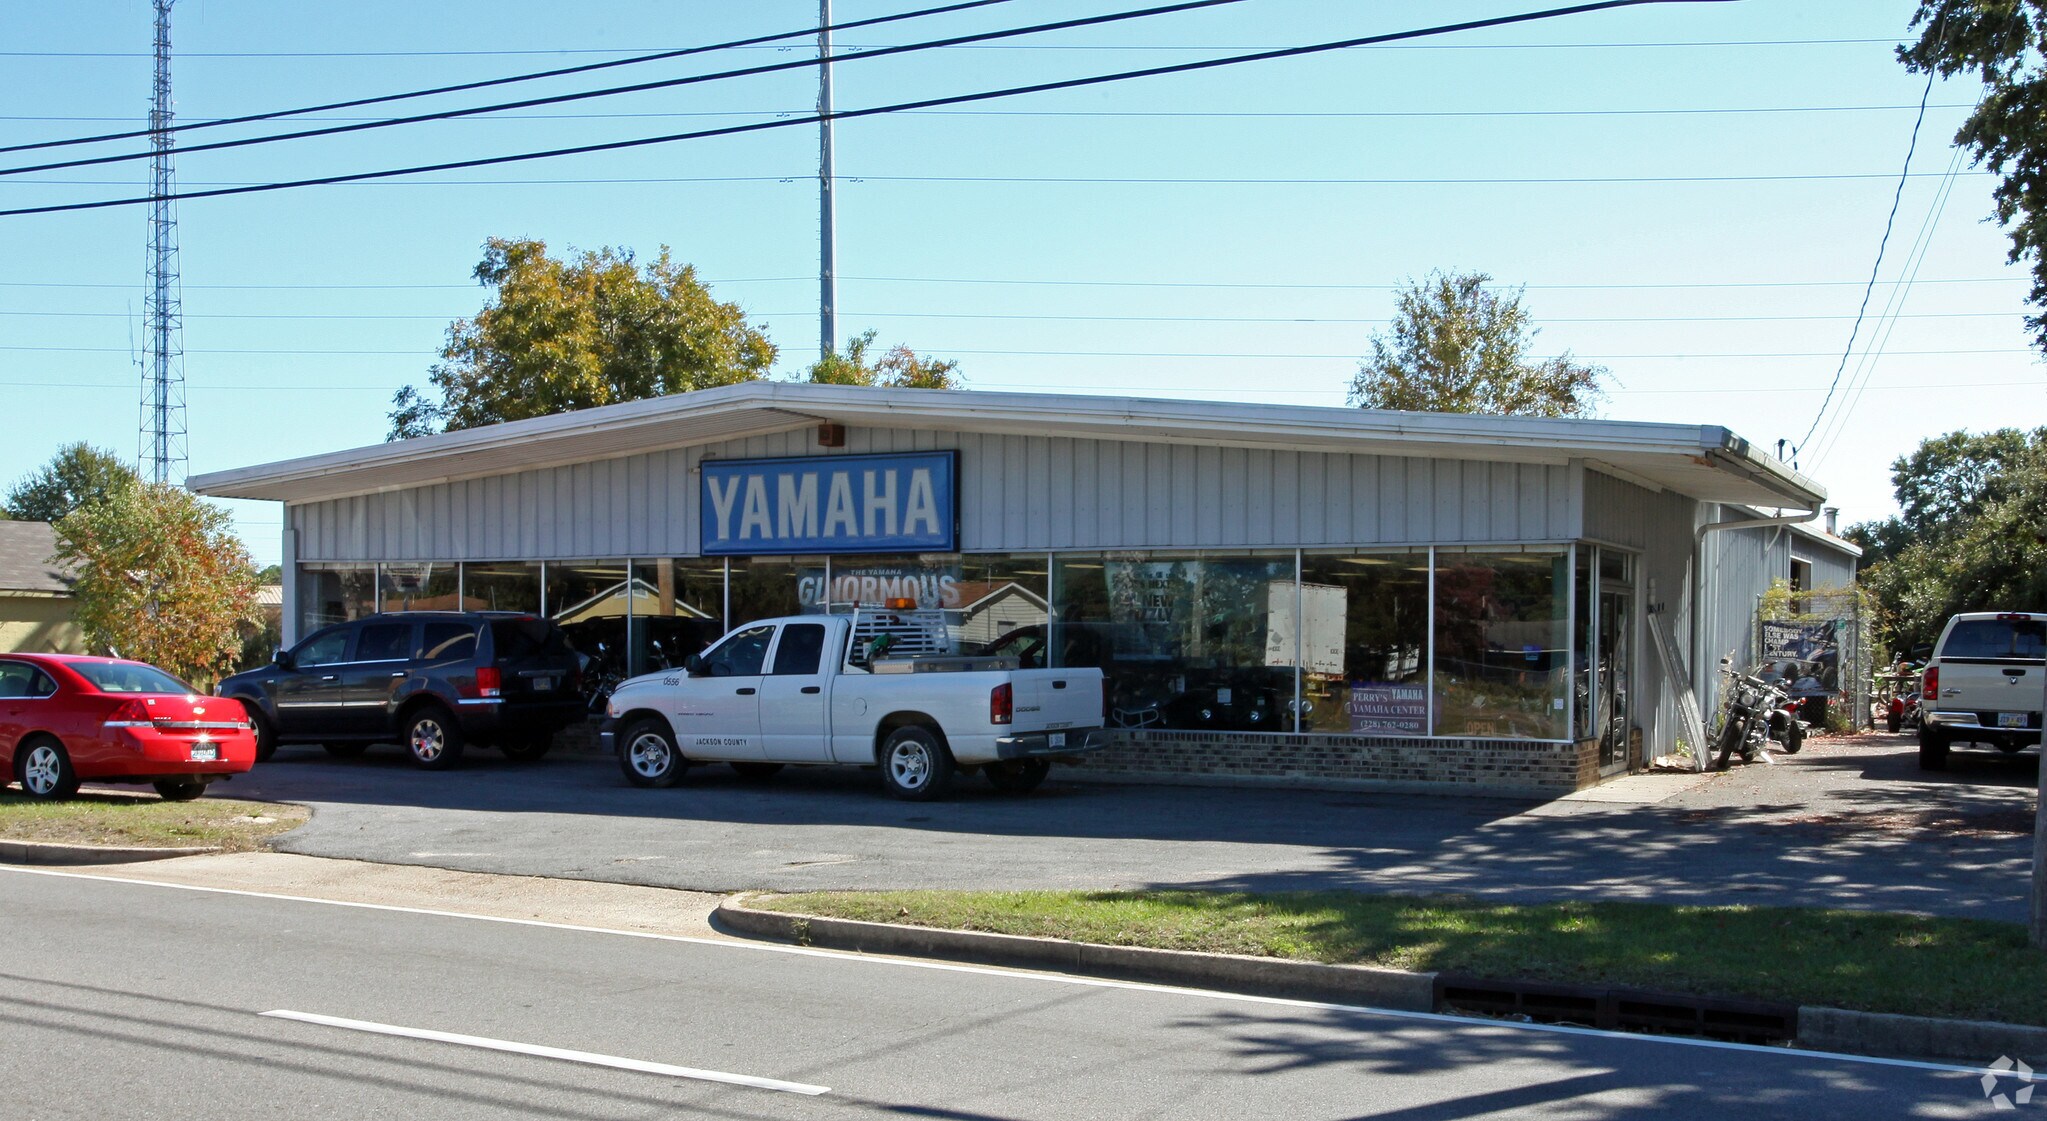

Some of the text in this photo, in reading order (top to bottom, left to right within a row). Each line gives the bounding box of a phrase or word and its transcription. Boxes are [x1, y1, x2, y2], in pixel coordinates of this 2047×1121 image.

[707, 467, 941, 541] YAMAHA
[868, 568, 902, 576] YAMAHA
[1764, 625, 1803, 634] SOMEBODY
[1764, 631, 1799, 640] ELSE WAS
[1764, 637, 1789, 645] CHAMP
[663, 677, 680, 686] 0556
[1353, 692, 1388, 702] PERRY'S
[1391, 688, 1424, 700] YAMAHA
[1353, 704, 1426, 715] YAMAHA CENTER
[1360, 719, 1419, 730] (228) 762-0280
[1467, 721, 1495, 735] OPEN
[696, 738, 747, 746] JACKSON COUNTY
